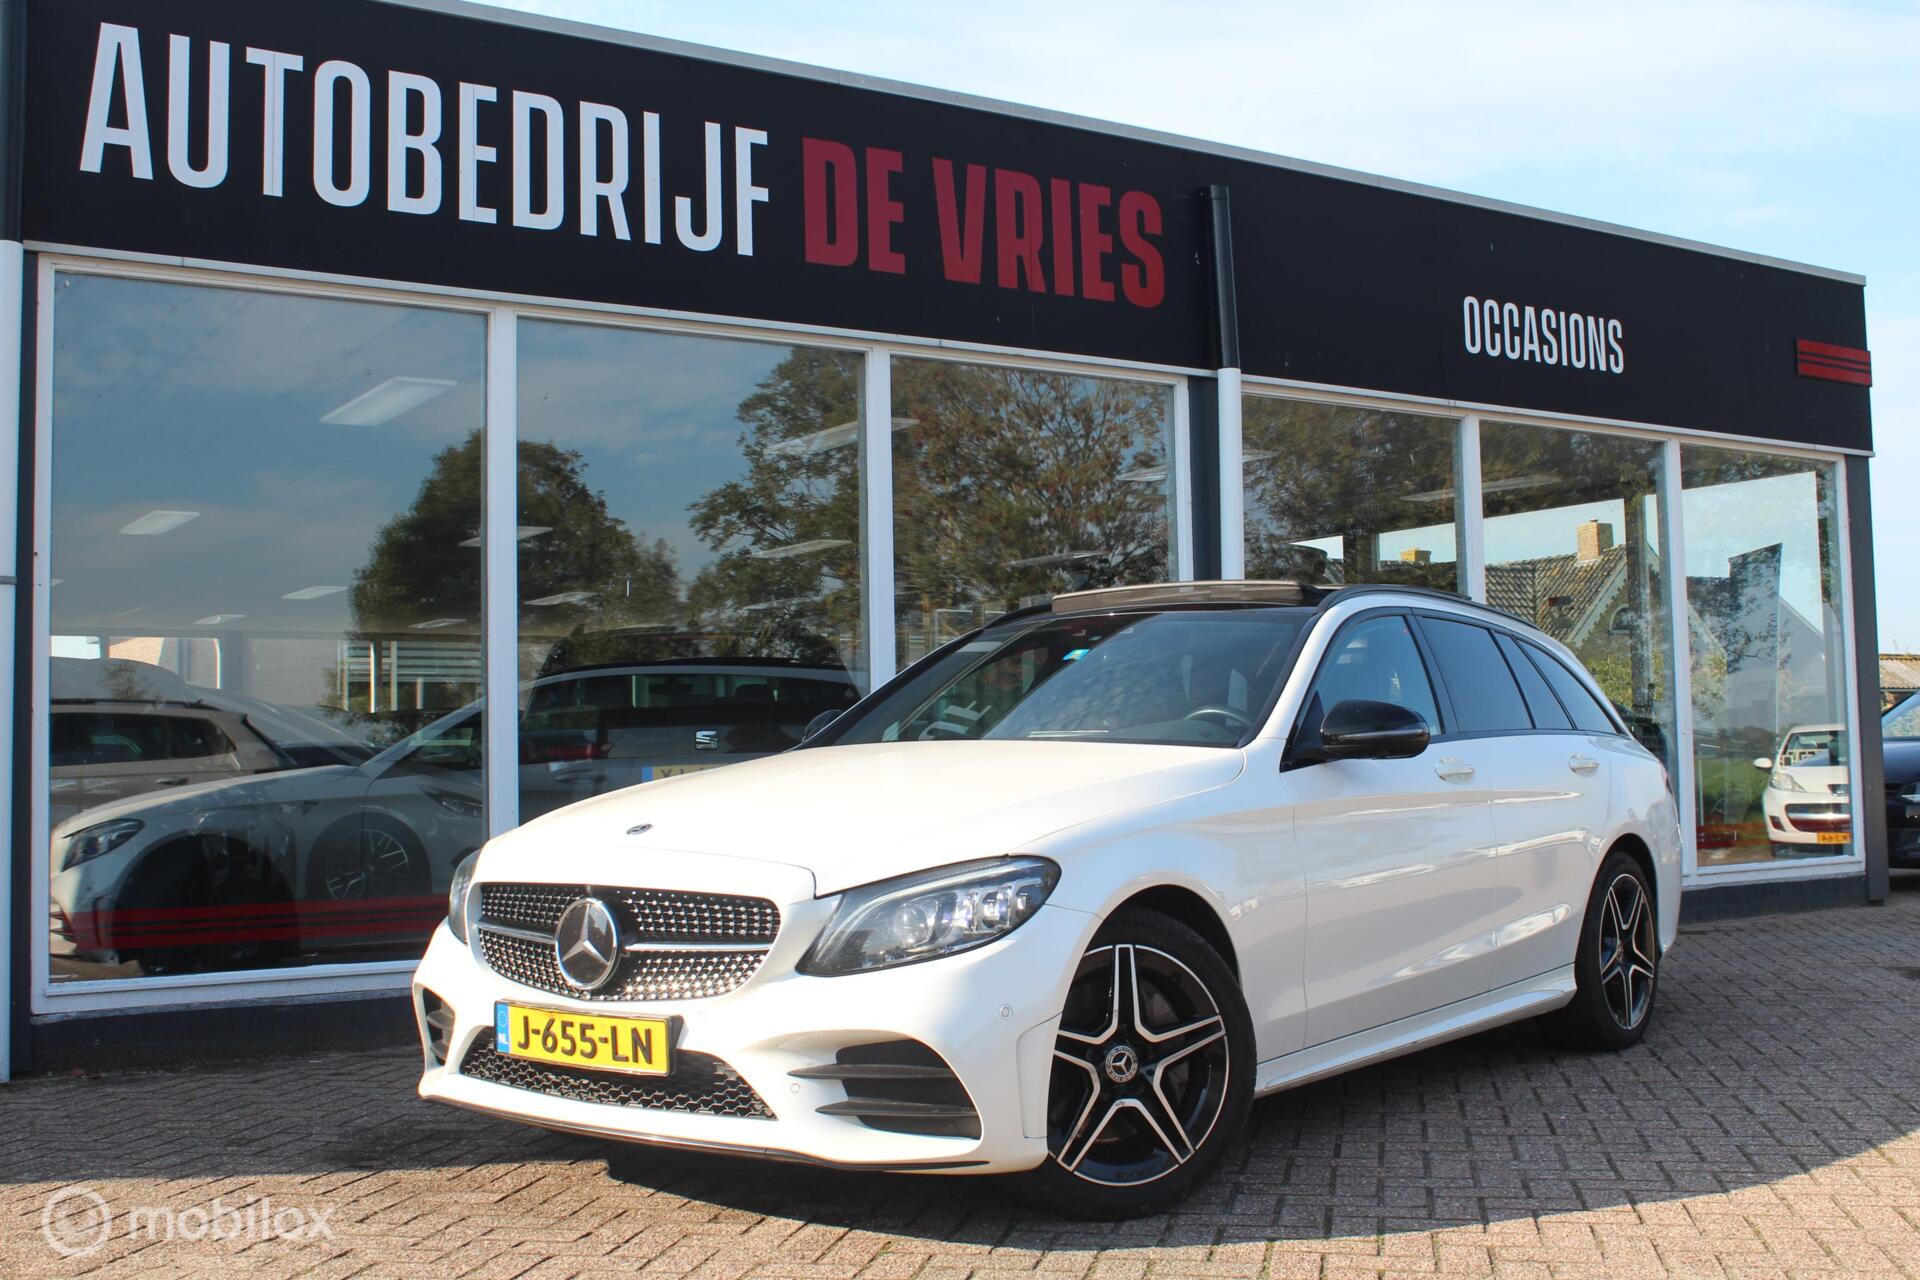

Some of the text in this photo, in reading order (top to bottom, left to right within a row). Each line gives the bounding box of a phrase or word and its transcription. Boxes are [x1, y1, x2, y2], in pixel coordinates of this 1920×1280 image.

[80, 22, 1165, 308] AUTOBEDRIJF DE VRIES
[1463, 295, 1624, 374] OCCASIONS
[517, 1015, 653, 1064] J-655-LN
